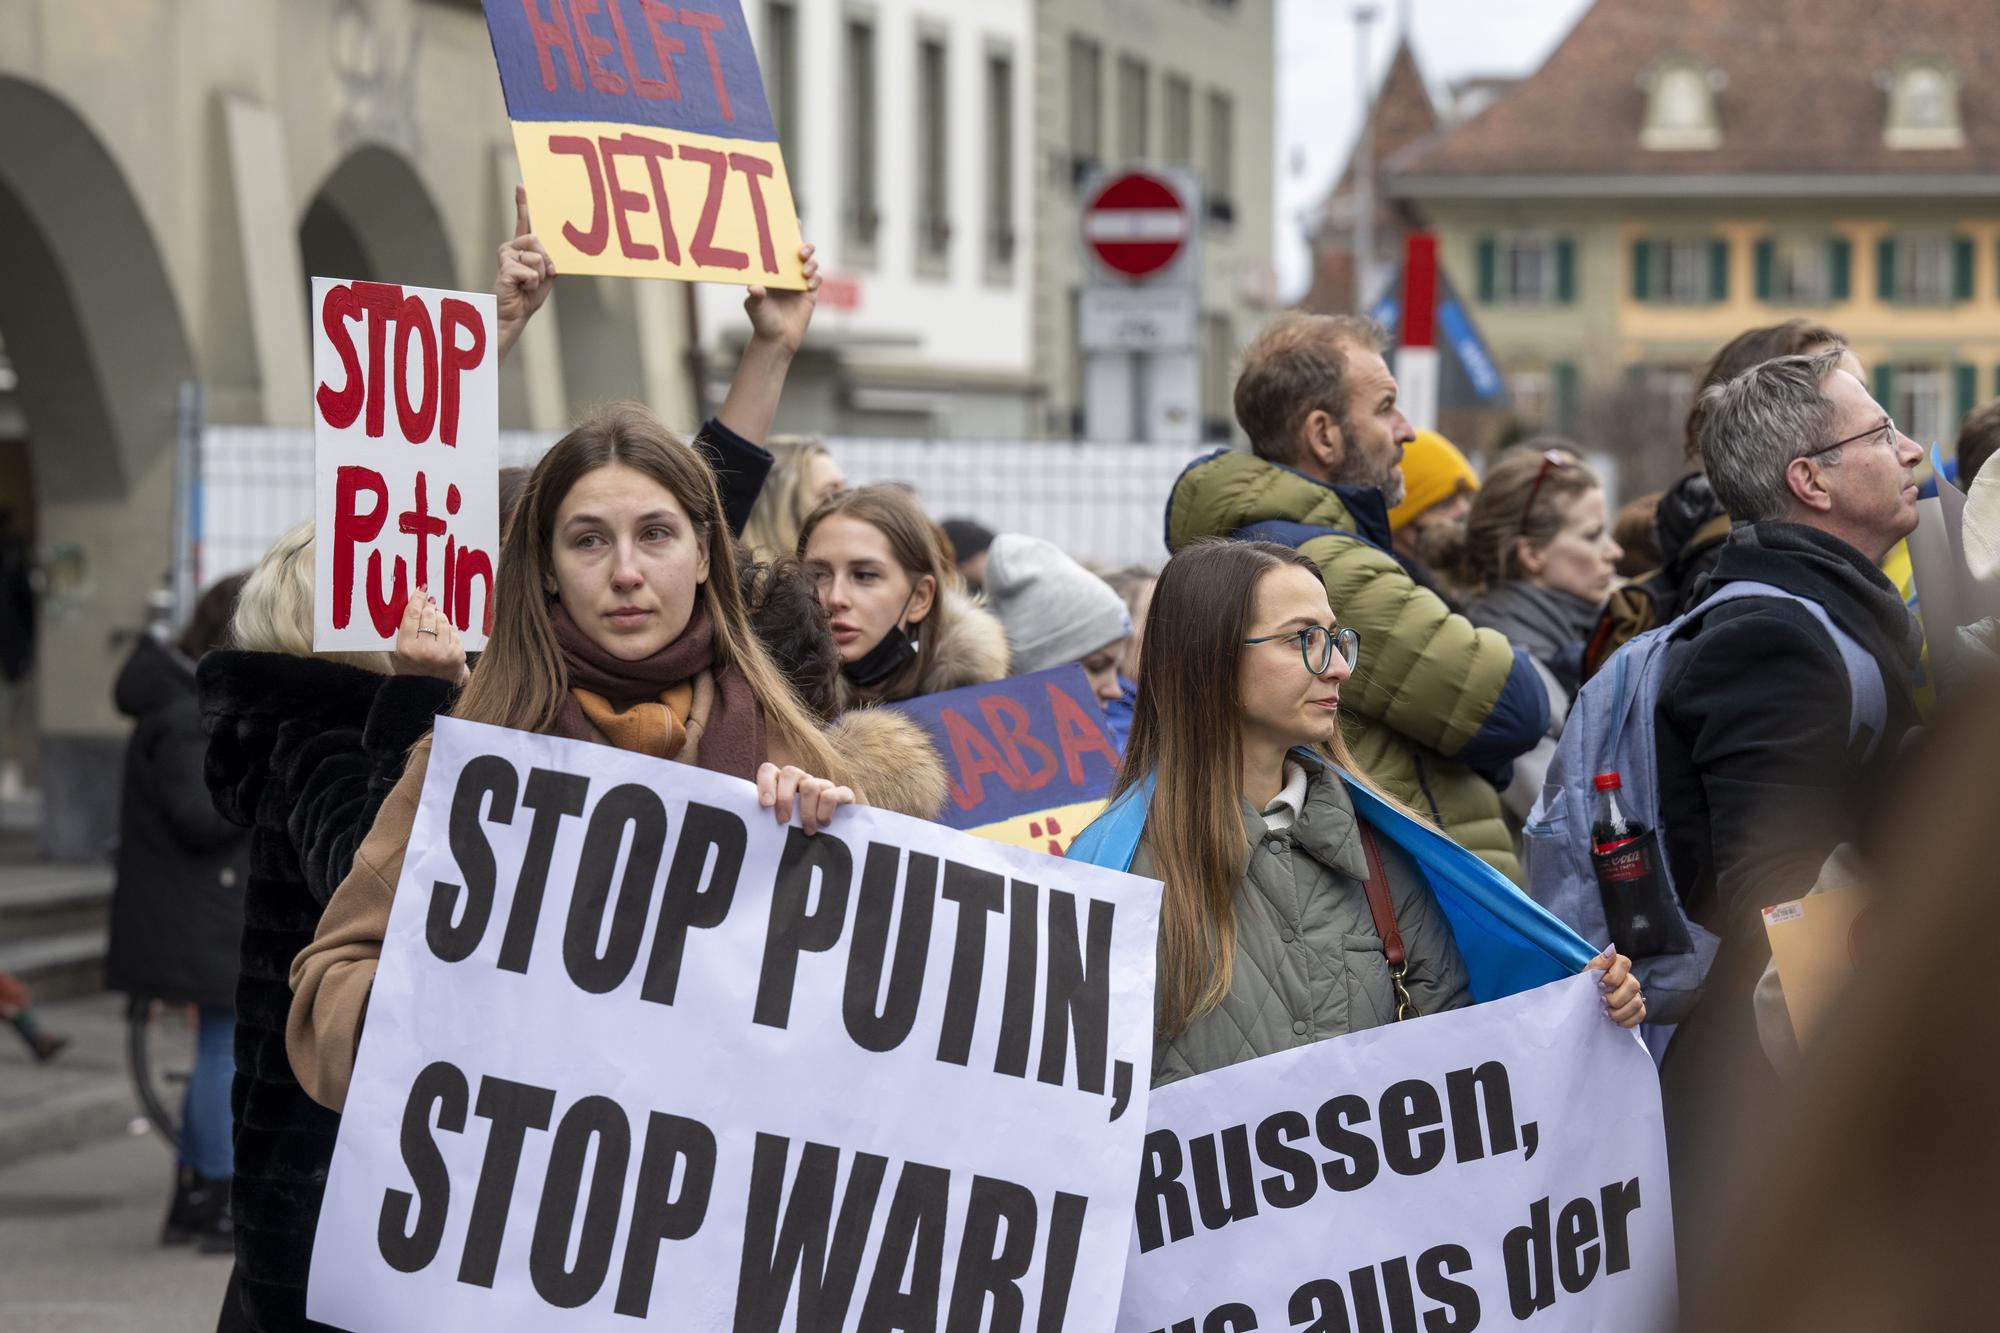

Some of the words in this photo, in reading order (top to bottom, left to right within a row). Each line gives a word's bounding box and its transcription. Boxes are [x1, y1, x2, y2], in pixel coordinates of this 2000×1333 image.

[521, 0, 735, 122] HELFT
[548, 132, 779, 274] JETZT
[316, 281, 486, 448] STOP
[333, 466, 494, 639] Putin
[425, 754, 748, 1007] STOP
[752, 825, 1134, 1123] PUTIN,
[377, 1061, 717, 1320] STOP
[1135, 1060, 1539, 1254] Russen,
[1503, 1176, 1641, 1321] der
